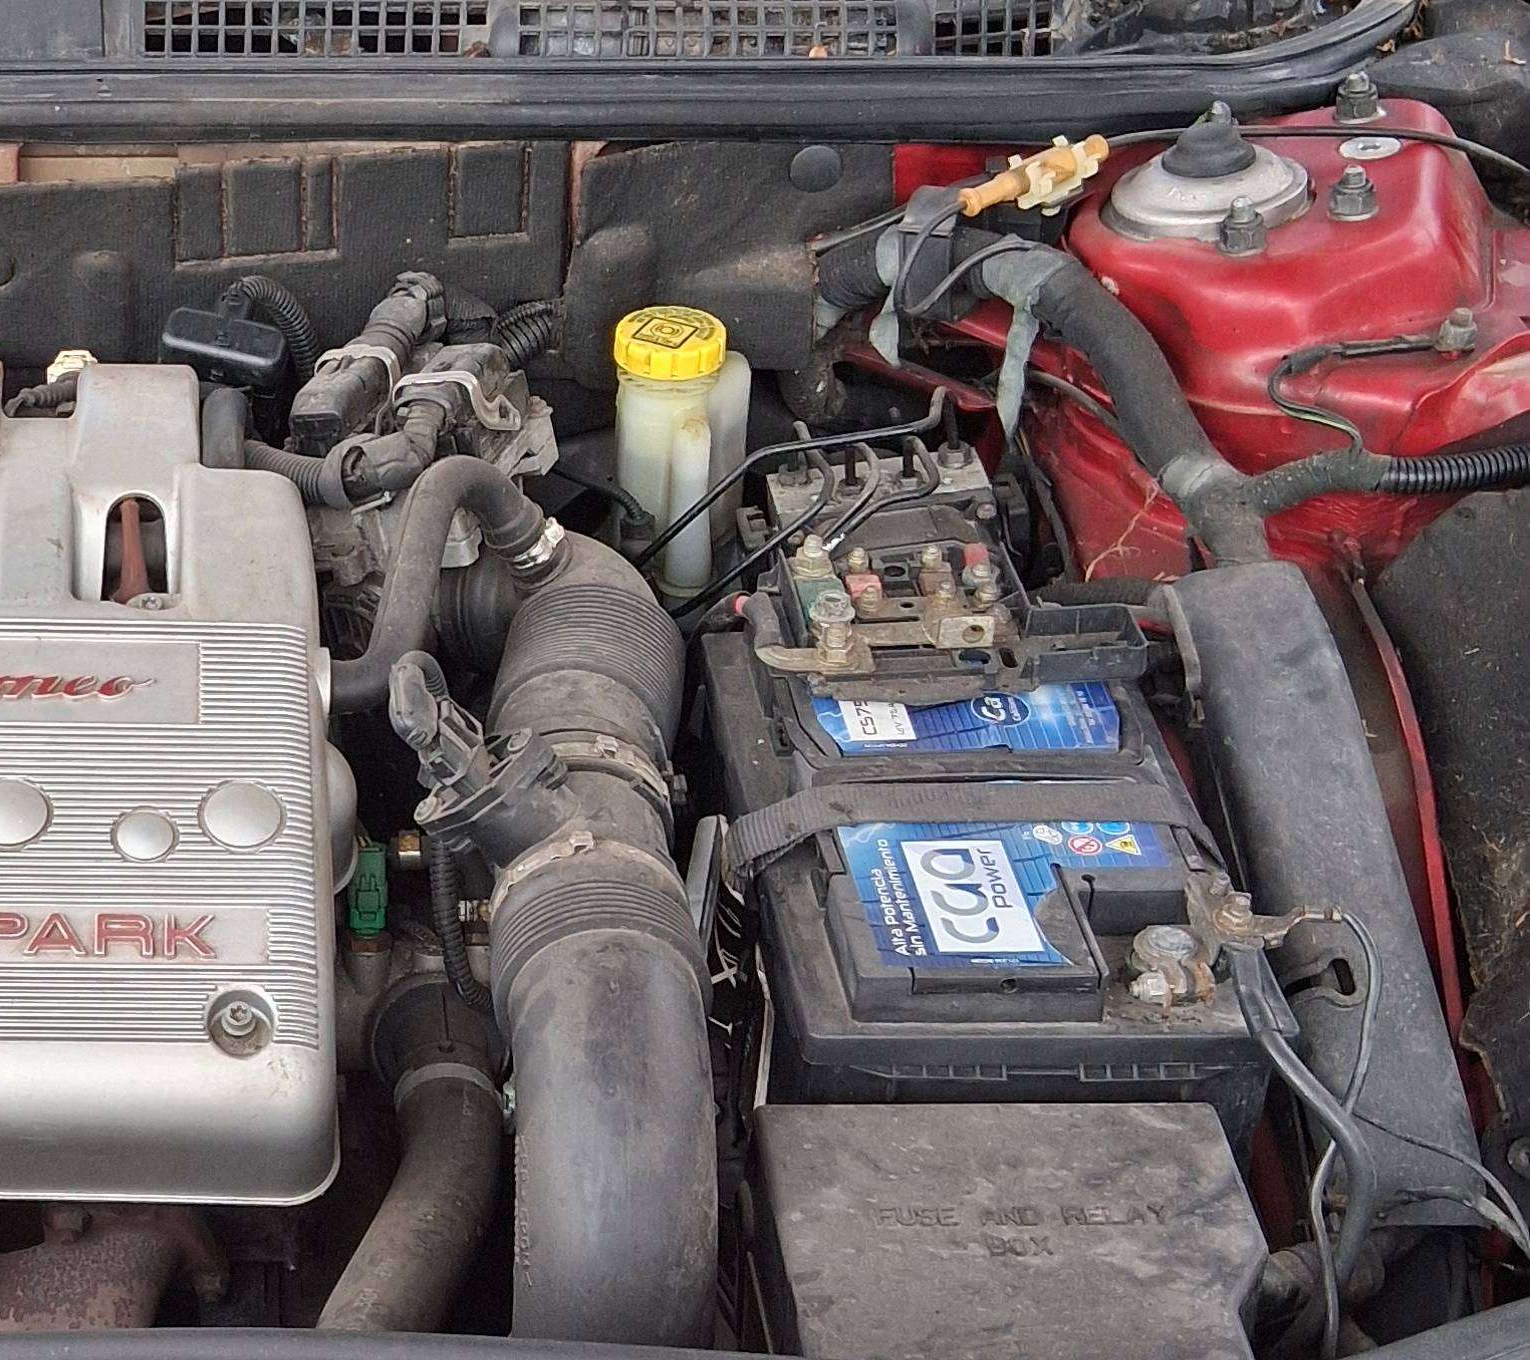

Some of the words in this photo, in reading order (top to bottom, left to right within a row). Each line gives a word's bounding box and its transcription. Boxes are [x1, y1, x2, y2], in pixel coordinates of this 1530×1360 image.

[871, 868, 901, 923] Potencia
[878, 839, 918, 935] Mantenimiento
[906, 936, 928, 957] sin
[872, 1206, 961, 1227] FUSE
[980, 1205, 1043, 1227] AND
[1059, 1204, 1167, 1226] RELAY
[986, 1235, 1055, 1257] BOX
